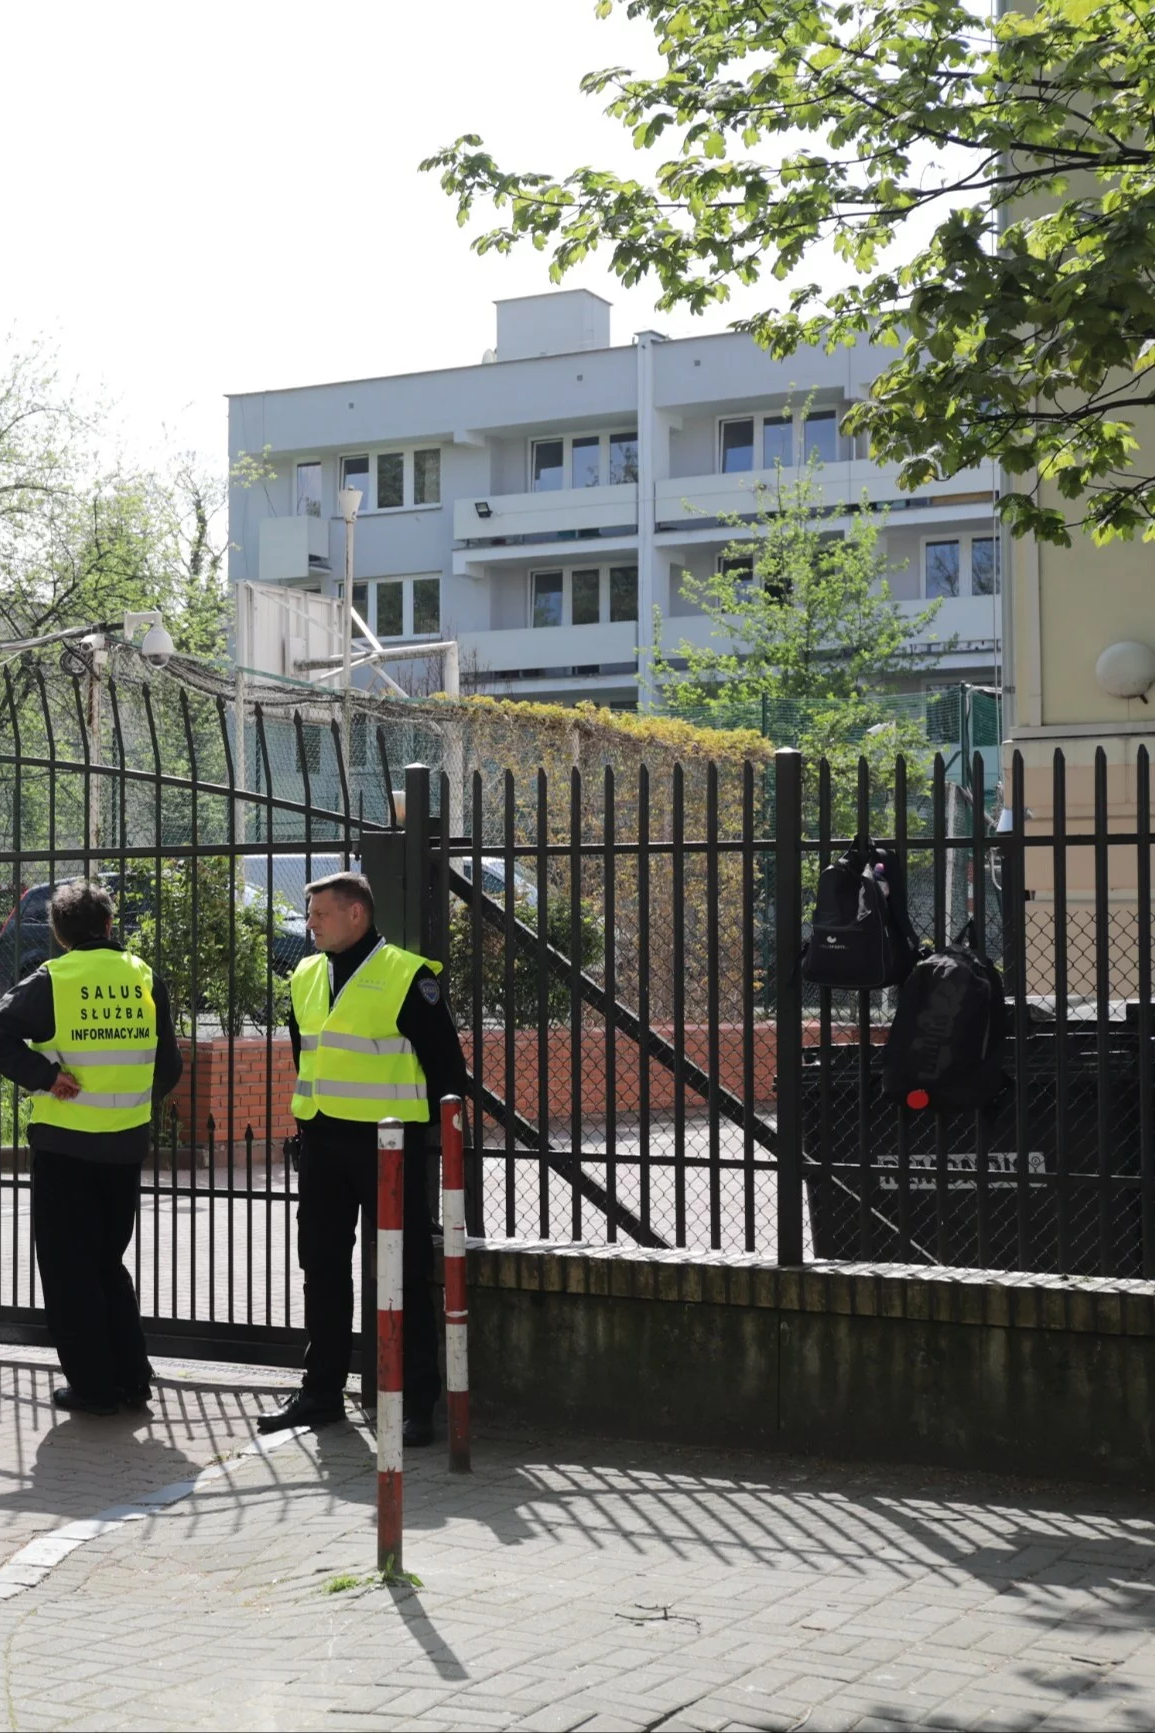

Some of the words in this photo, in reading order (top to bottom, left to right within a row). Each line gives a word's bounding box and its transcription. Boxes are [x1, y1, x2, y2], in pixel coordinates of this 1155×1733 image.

[80, 985, 143, 1000] SALUS
[80, 1005, 144, 1020] SŁUŻBA
[71, 1027, 150, 1041] INFORMACYJNA
